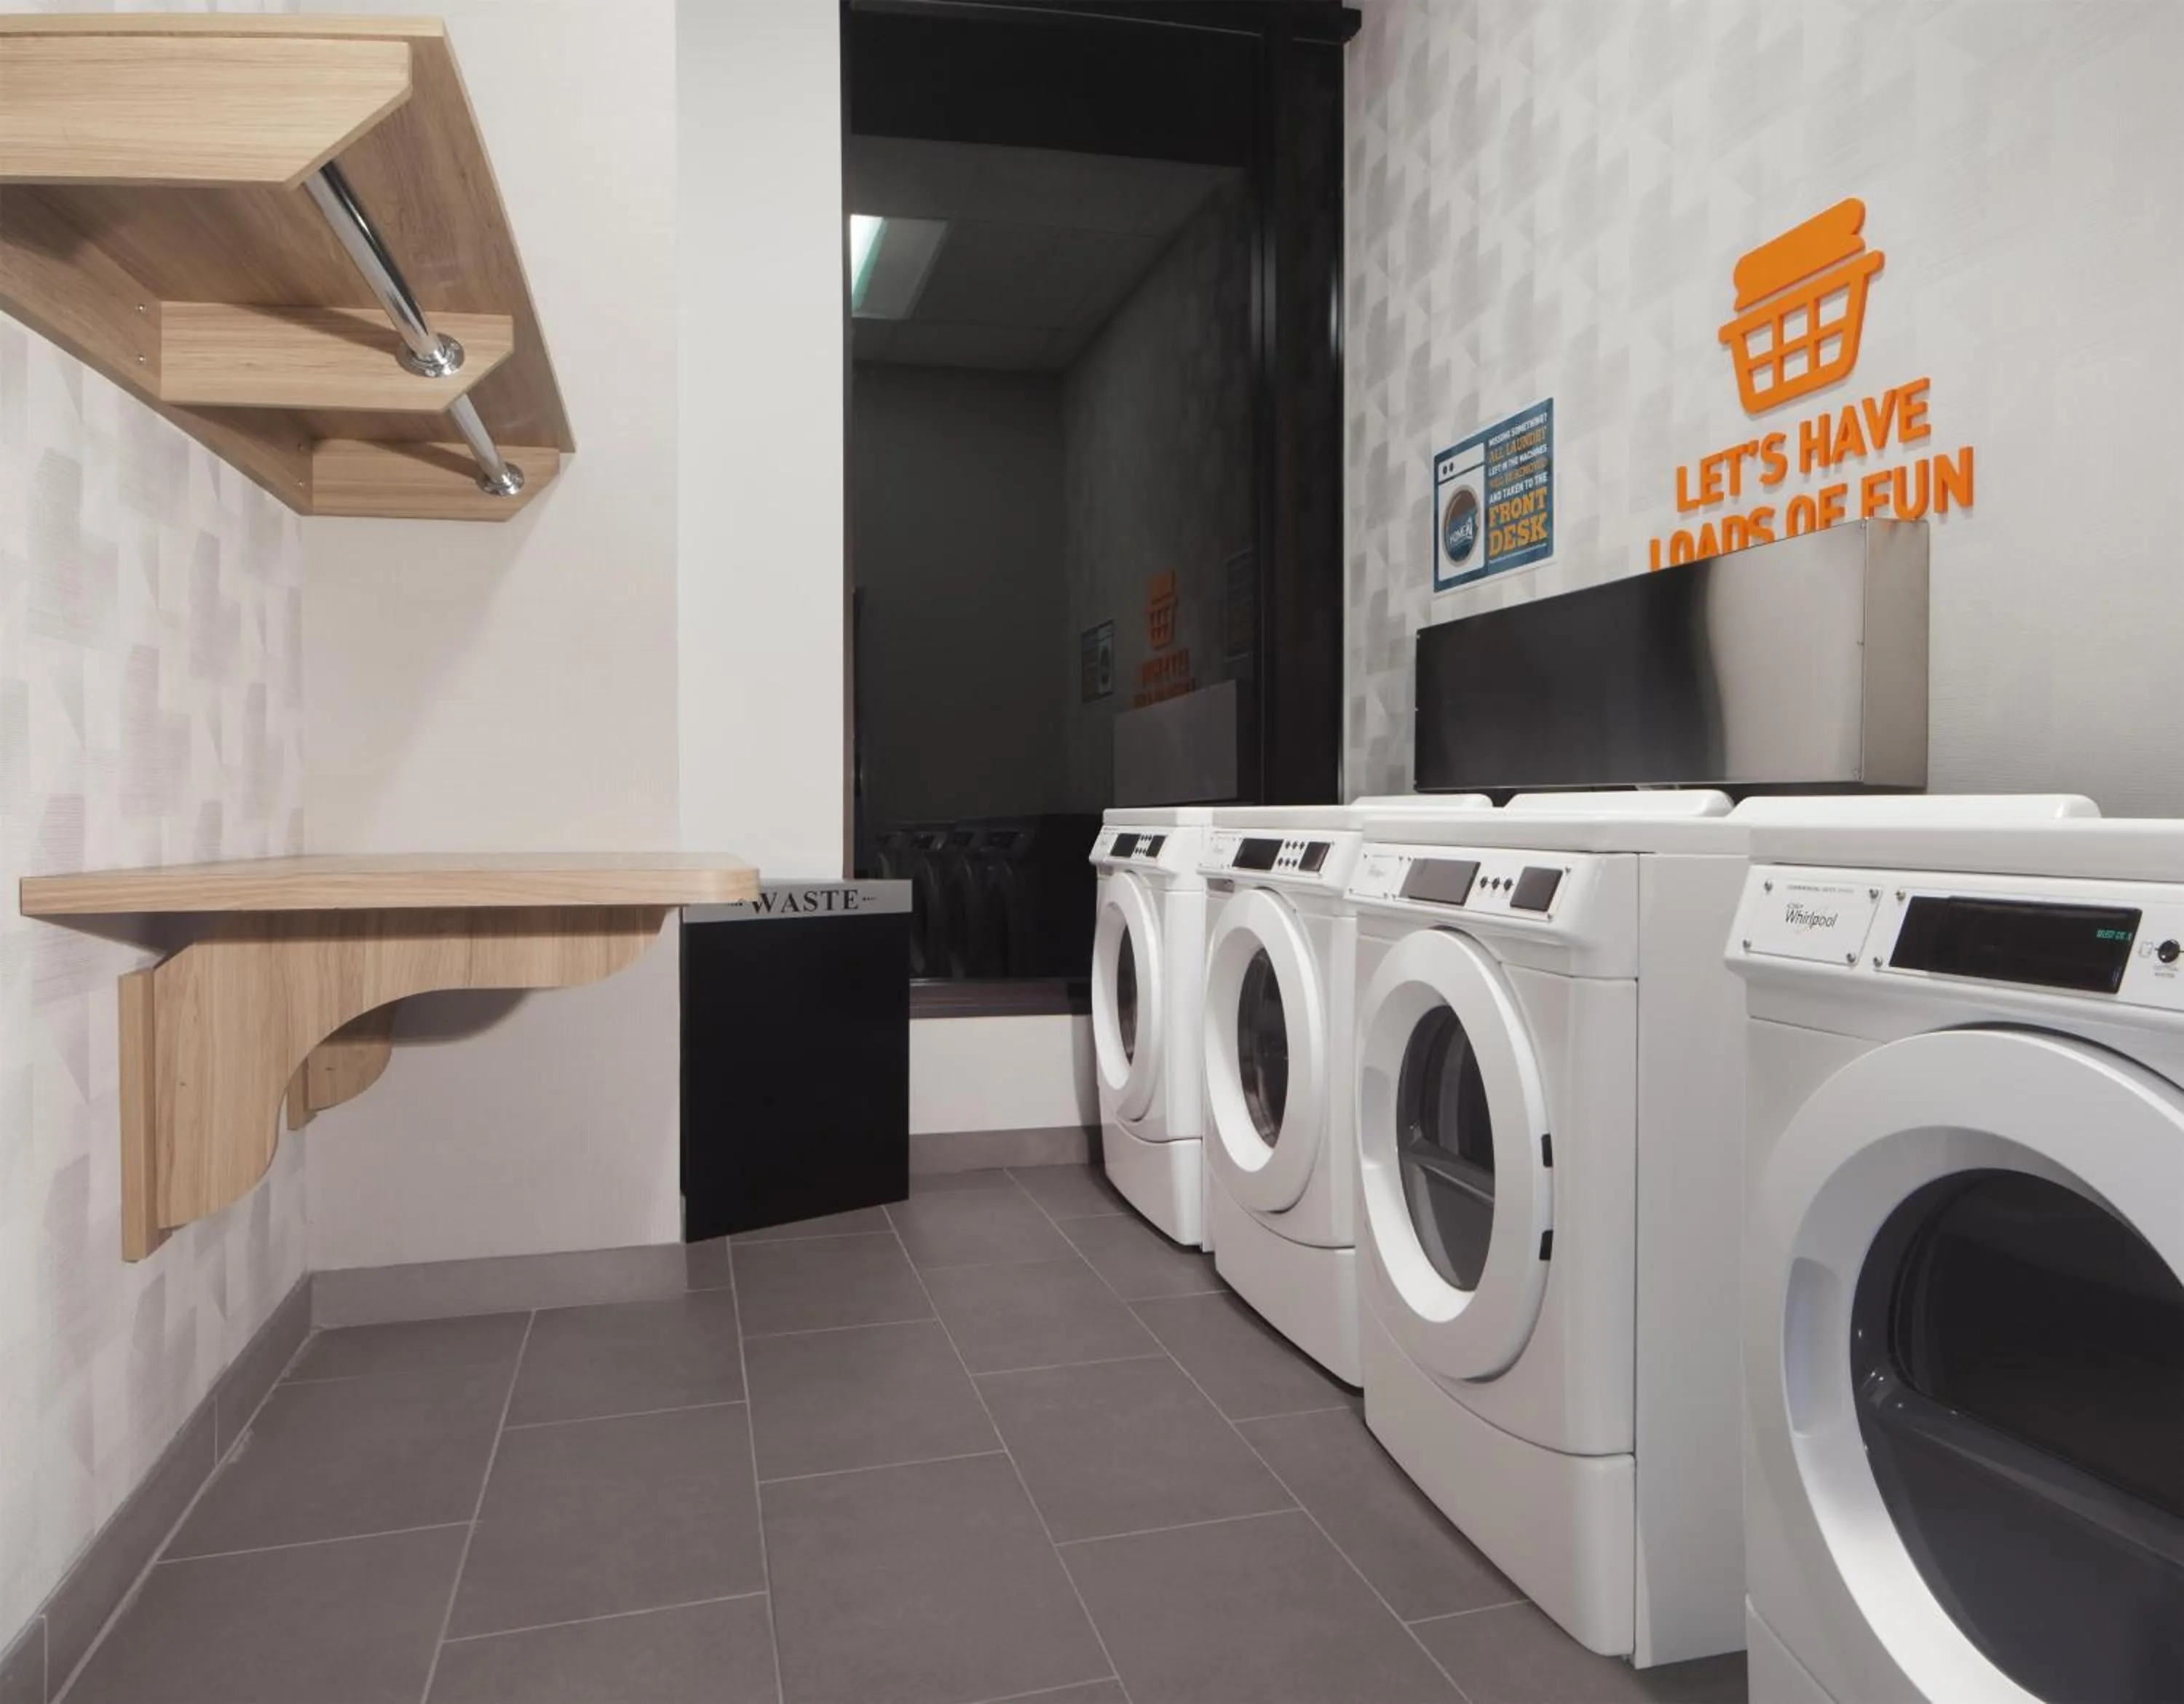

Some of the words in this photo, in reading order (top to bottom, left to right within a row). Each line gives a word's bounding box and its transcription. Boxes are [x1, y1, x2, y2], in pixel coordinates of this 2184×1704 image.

[1677, 432, 1788, 513] LET'S
[1799, 377, 1931, 474] HAVE
[1489, 490, 1502, 504] AND
[1503, 481, 1524, 498] TAKEN
[1524, 477, 1534, 490] TO
[1535, 471, 1548, 486] THE
[1489, 486, 1548, 526] FRONT
[1649, 507, 1776, 572] LOADS
[1786, 484, 1848, 535] OF
[1861, 446, 1974, 521] FUN
[1489, 512, 1548, 558] DESK
[751, 889, 859, 915] WASTE
[1786, 910, 1838, 929] Whirlpool
